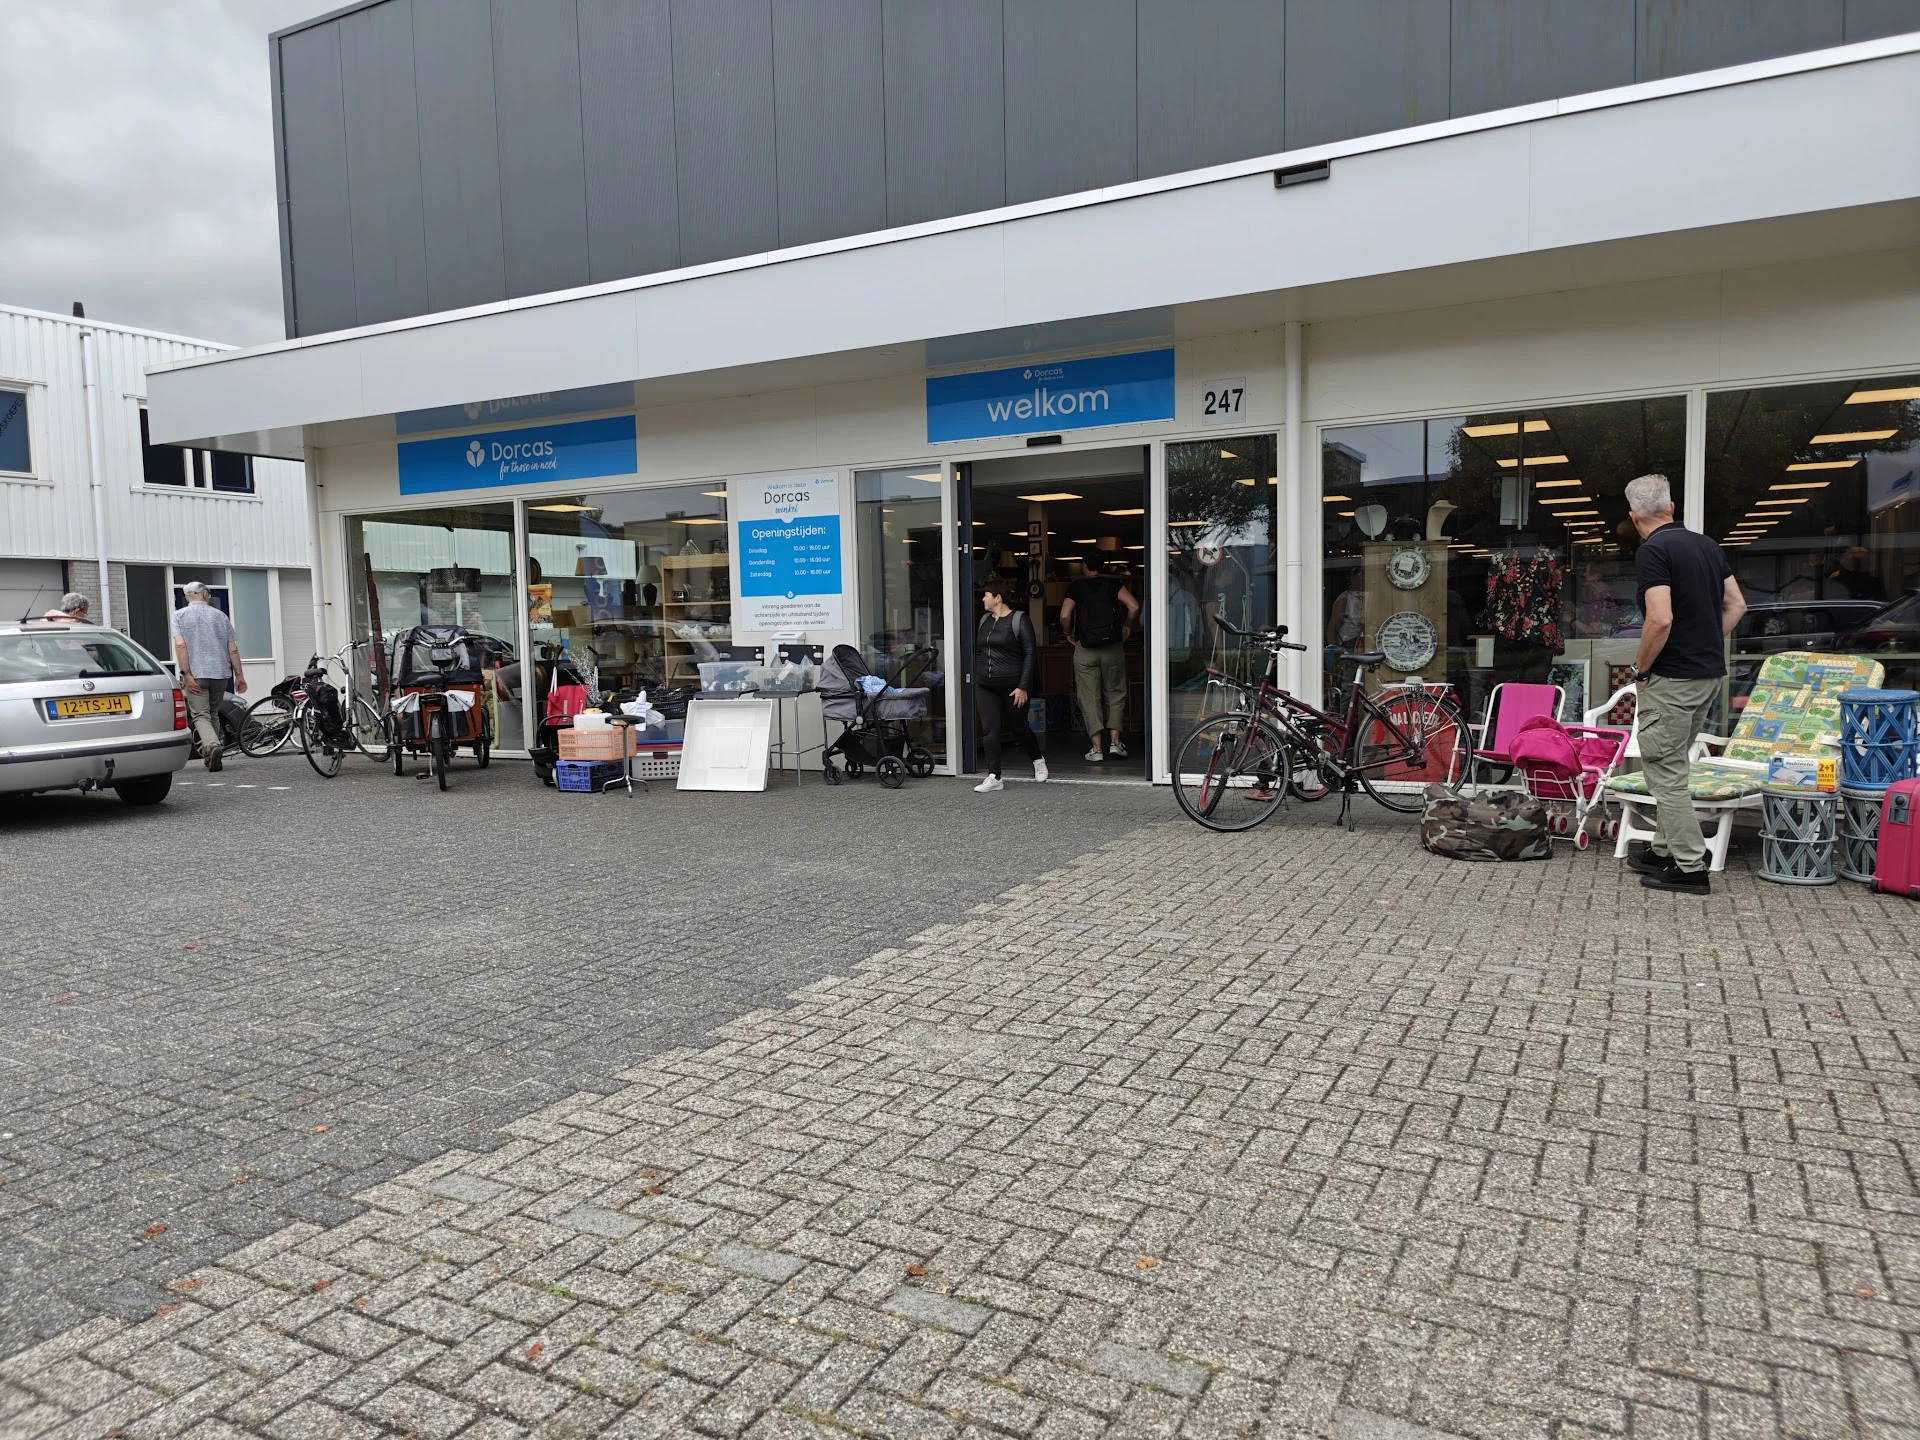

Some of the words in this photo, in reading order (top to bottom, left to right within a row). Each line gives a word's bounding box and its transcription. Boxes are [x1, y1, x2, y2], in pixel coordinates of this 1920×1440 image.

[1035, 368, 1063, 378] Dorcas
[987, 387, 1109, 422] welkom
[1205, 388, 1244, 415] 247
[492, 440, 554, 461] Dorcas
[499, 461, 510, 480] for
[511, 461, 530, 473] those
[530, 461, 540, 470] in
[540, 456, 558, 470] need
[764, 491, 810, 504] Dorcas
[775, 503, 799, 514] winkel
[752, 525, 826, 541] Openingstijden:
[1390, 710, 1444, 728] MALCIEUX
[1818, 763, 1835, 772] 2+1
